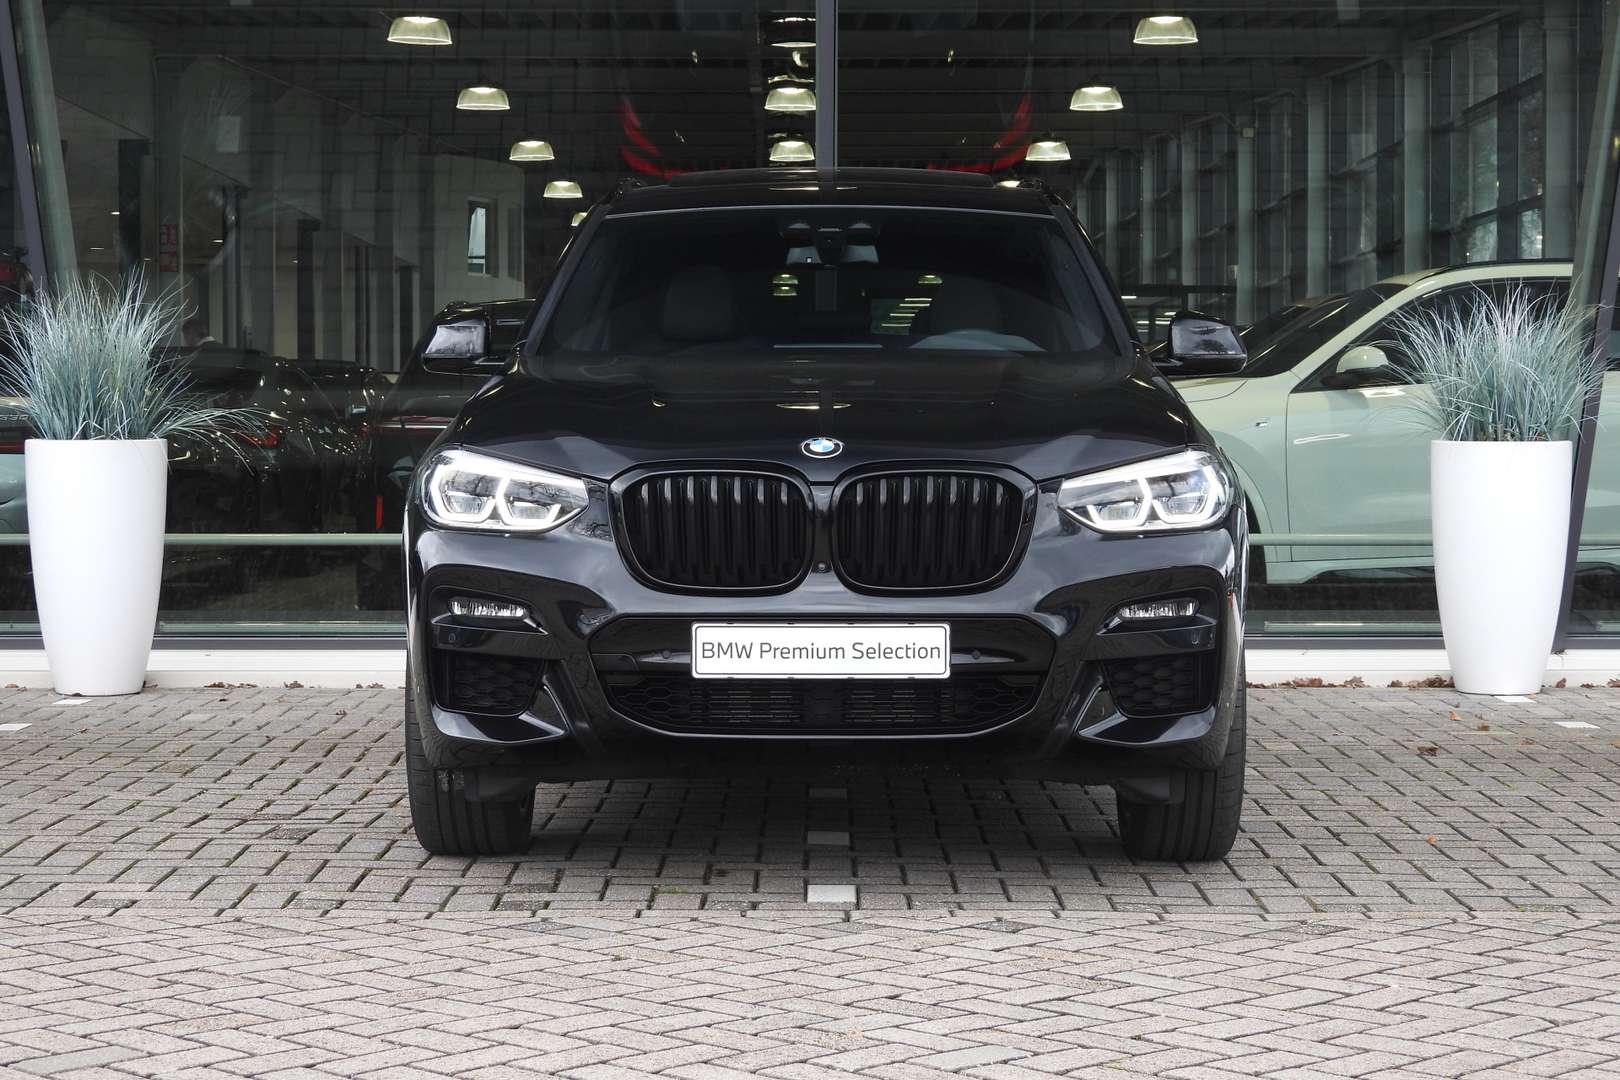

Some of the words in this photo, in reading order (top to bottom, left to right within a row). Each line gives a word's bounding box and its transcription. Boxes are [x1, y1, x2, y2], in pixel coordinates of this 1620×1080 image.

[702, 642, 753, 659] BMW
[759, 642, 845, 659] Premium
[851, 642, 941, 660] Selection
